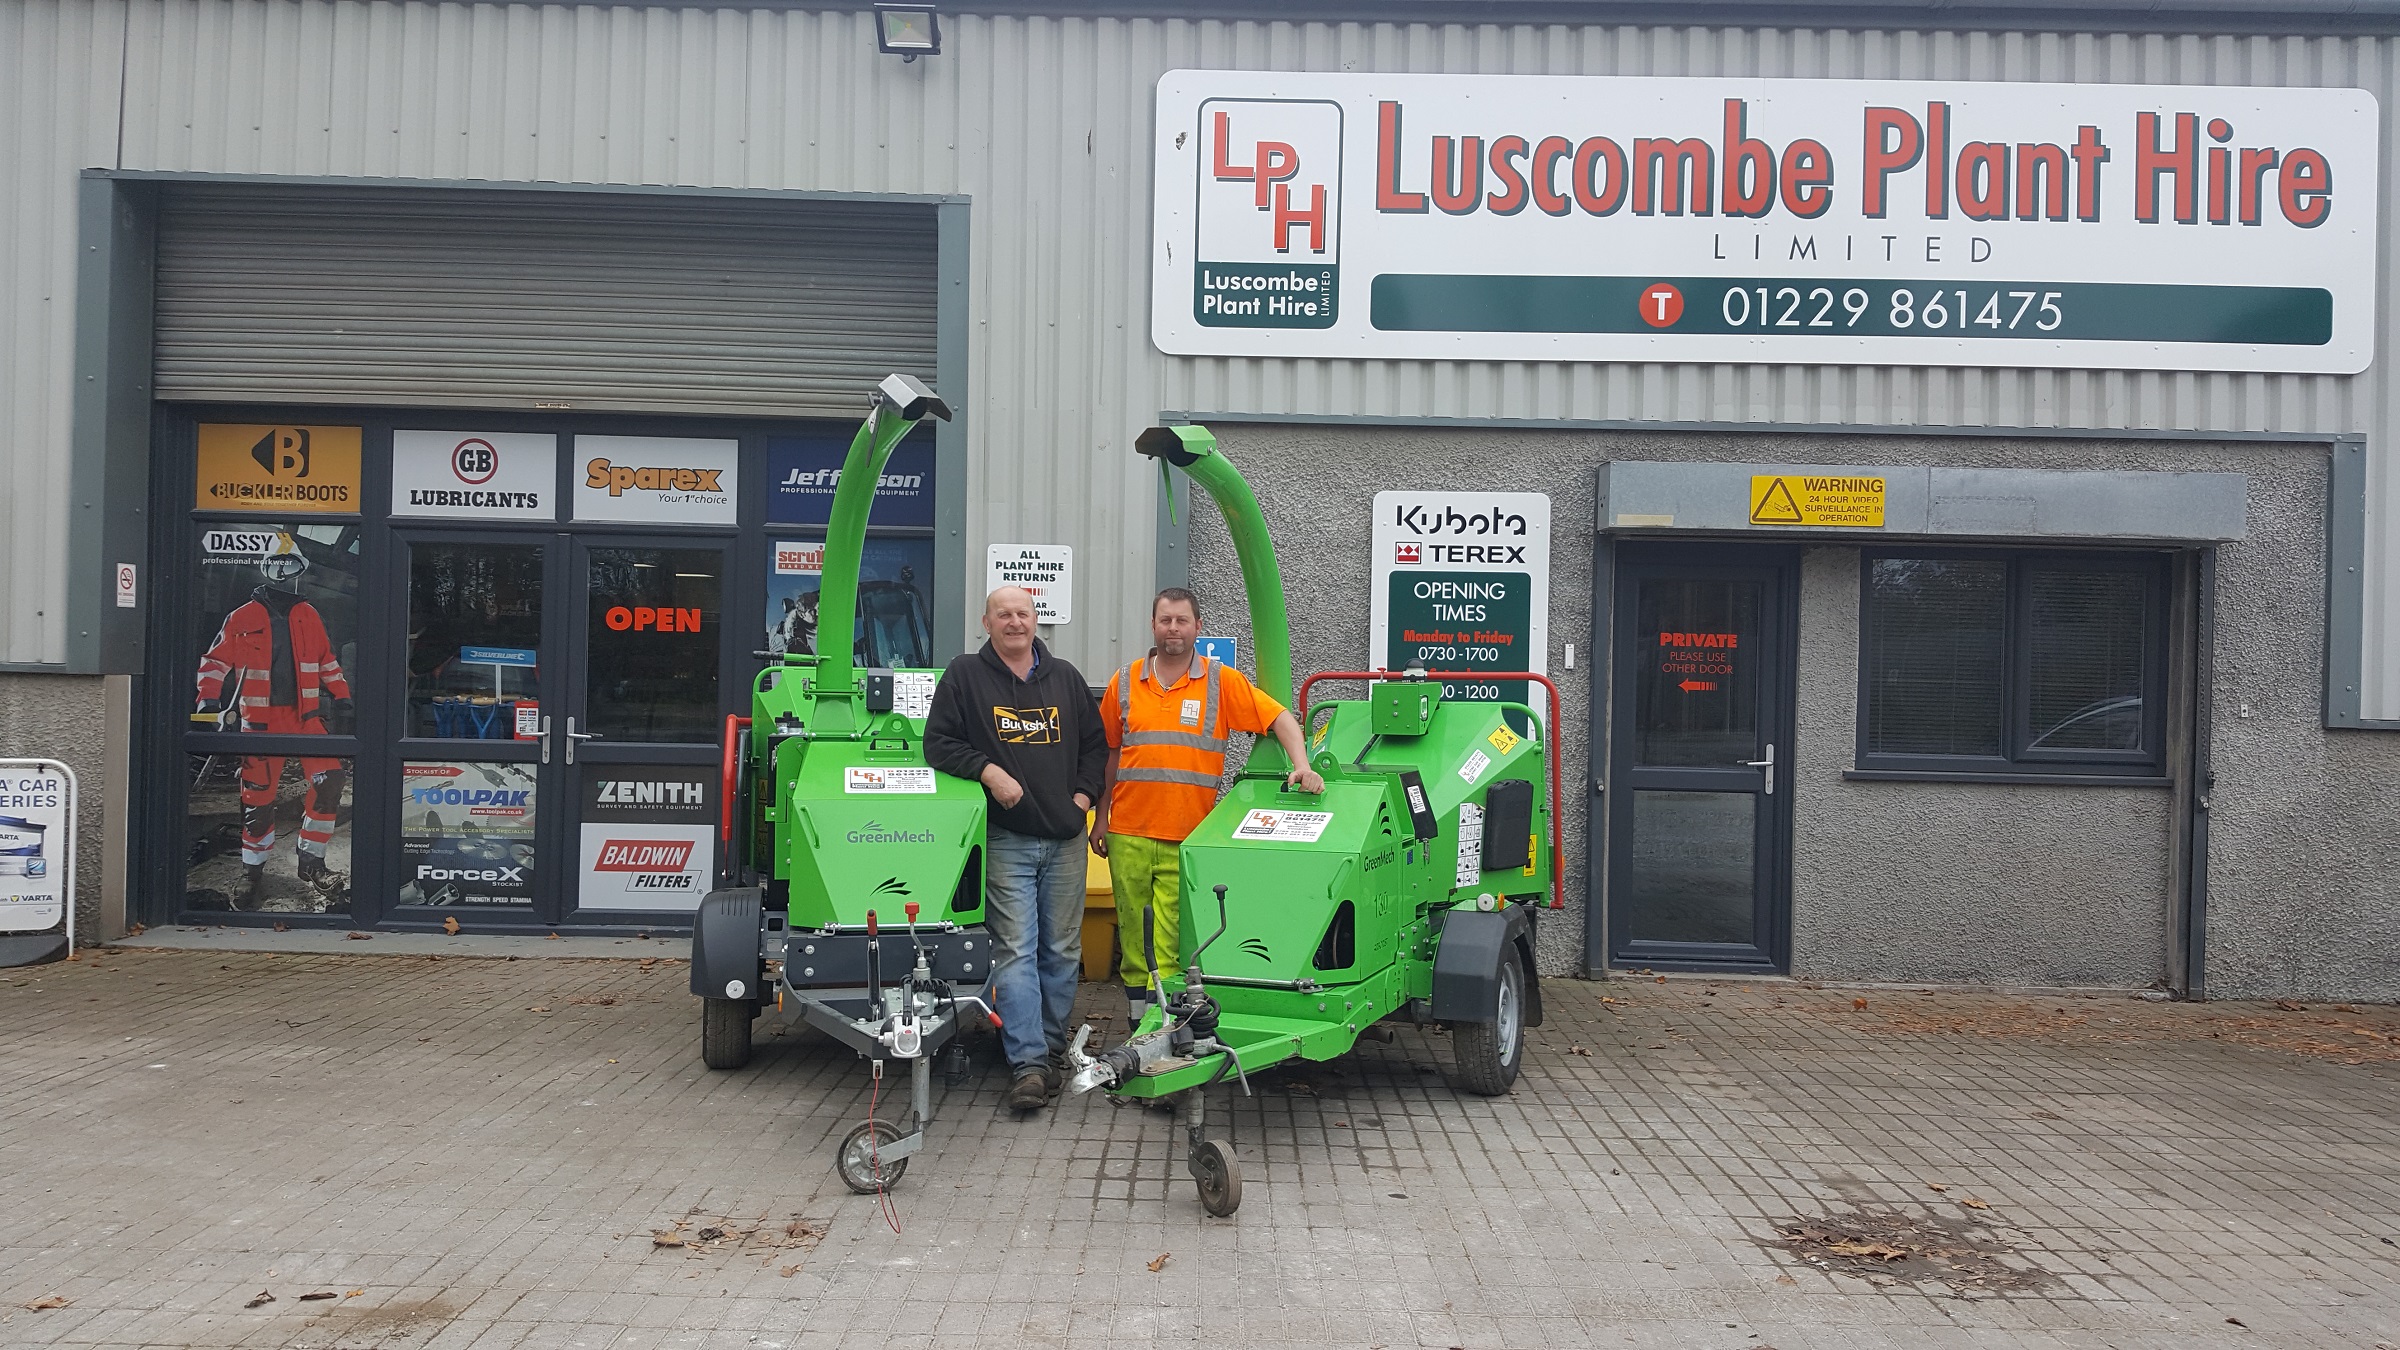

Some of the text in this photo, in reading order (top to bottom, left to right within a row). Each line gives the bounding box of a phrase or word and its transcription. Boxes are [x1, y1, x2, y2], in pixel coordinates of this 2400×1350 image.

[1374, 98, 2333, 229] Luscombe Plant Hire
[1714, 233, 1993, 262] LIMITED
[1203, 269, 1318, 292] Luscombe
[1320, 270, 1331, 317] LIMITED
[1203, 293, 1318, 317] Plant Hire
[1722, 286, 1869, 328] 01229
[1889, 288, 2063, 331] 861475
[458, 449, 492, 473] GB
[585, 457, 724, 497] Sparex
[1803, 478, 1883, 493] WARNING
[215, 482, 348, 501] BUCKLER BOOTS
[410, 489, 539, 509] LUBRICANTS
[658, 493, 687, 503] Your
[694, 494, 728, 504] choice
[1809, 495, 1820, 503] 24
[1852, 496, 1879, 504] VIDEO
[1804, 504, 1870, 513] SURVEILLANCE
[1396, 504, 1527, 536] Kubota
[1818, 514, 1868, 522] OPERATION
[210, 533, 274, 552] DASSY
[202, 557, 251, 566] professional
[1020, 550, 1041, 559] ALL
[1429, 544, 1526, 564] TEREX
[995, 561, 1065, 571] PLANT HIRE
[1003, 572, 1056, 582] RETURNS
[1413, 580, 1506, 600] OPENING
[605, 605, 701, 633] OPEN
[1432, 604, 1487, 622] TIMES
[1403, 629, 1514, 646] Monday to Friday
[1660, 632, 1738, 648] PRIVATE
[1418, 646, 1456, 660] 0730
[1670, 651, 1727, 662] PLEASE USE
[1662, 663, 1734, 674] OTHER DOOR
[19, 780, 57, 791] CAR
[597, 781, 703, 804] ZENITH
[411, 788, 531, 806] TOOLPAK
[846, 829, 935, 844] GreenMech
[602, 846, 687, 866] BALDWIN
[1364, 846, 1395, 873] GreenMech
[417, 864, 524, 882] ForceX
[635, 875, 693, 888] FILTERS
[21, 894, 53, 902] VARTA
